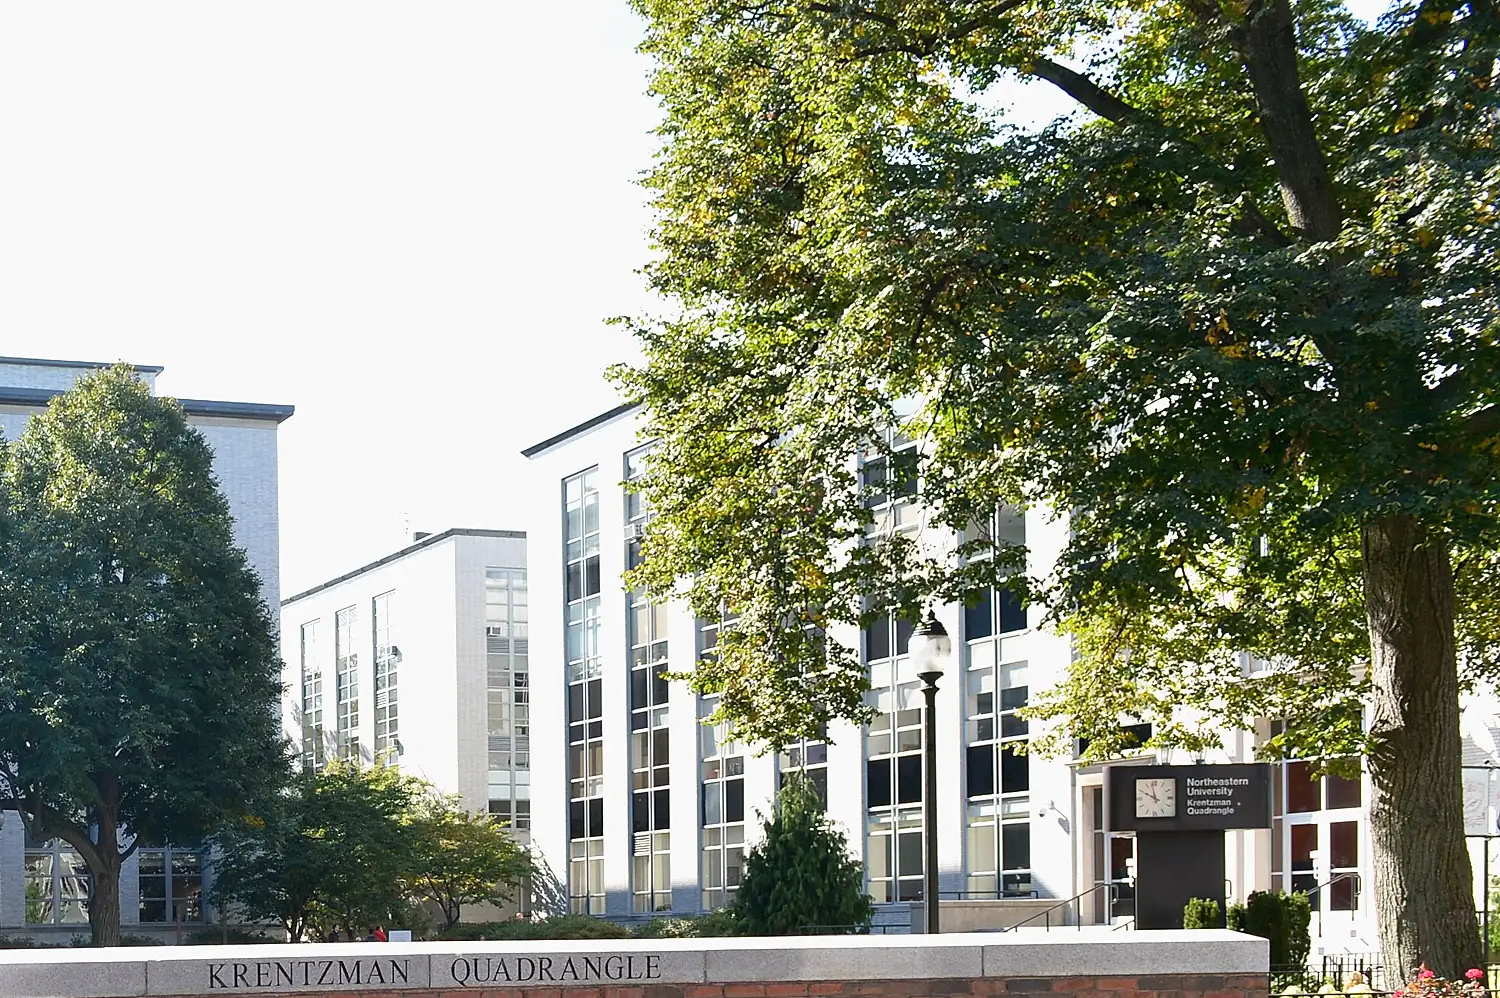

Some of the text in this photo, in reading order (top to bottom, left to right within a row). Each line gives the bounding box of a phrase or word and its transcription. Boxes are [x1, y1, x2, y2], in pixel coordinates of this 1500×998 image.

[1186, 777, 1249, 787] Northeastern
[1186, 787, 1233, 796] University
[1187, 799, 1231, 807] Krentzman
[1187, 807, 1235, 815] Quadrangle
[207, 954, 662, 989] KRENTZMAN QUADRANGLE
